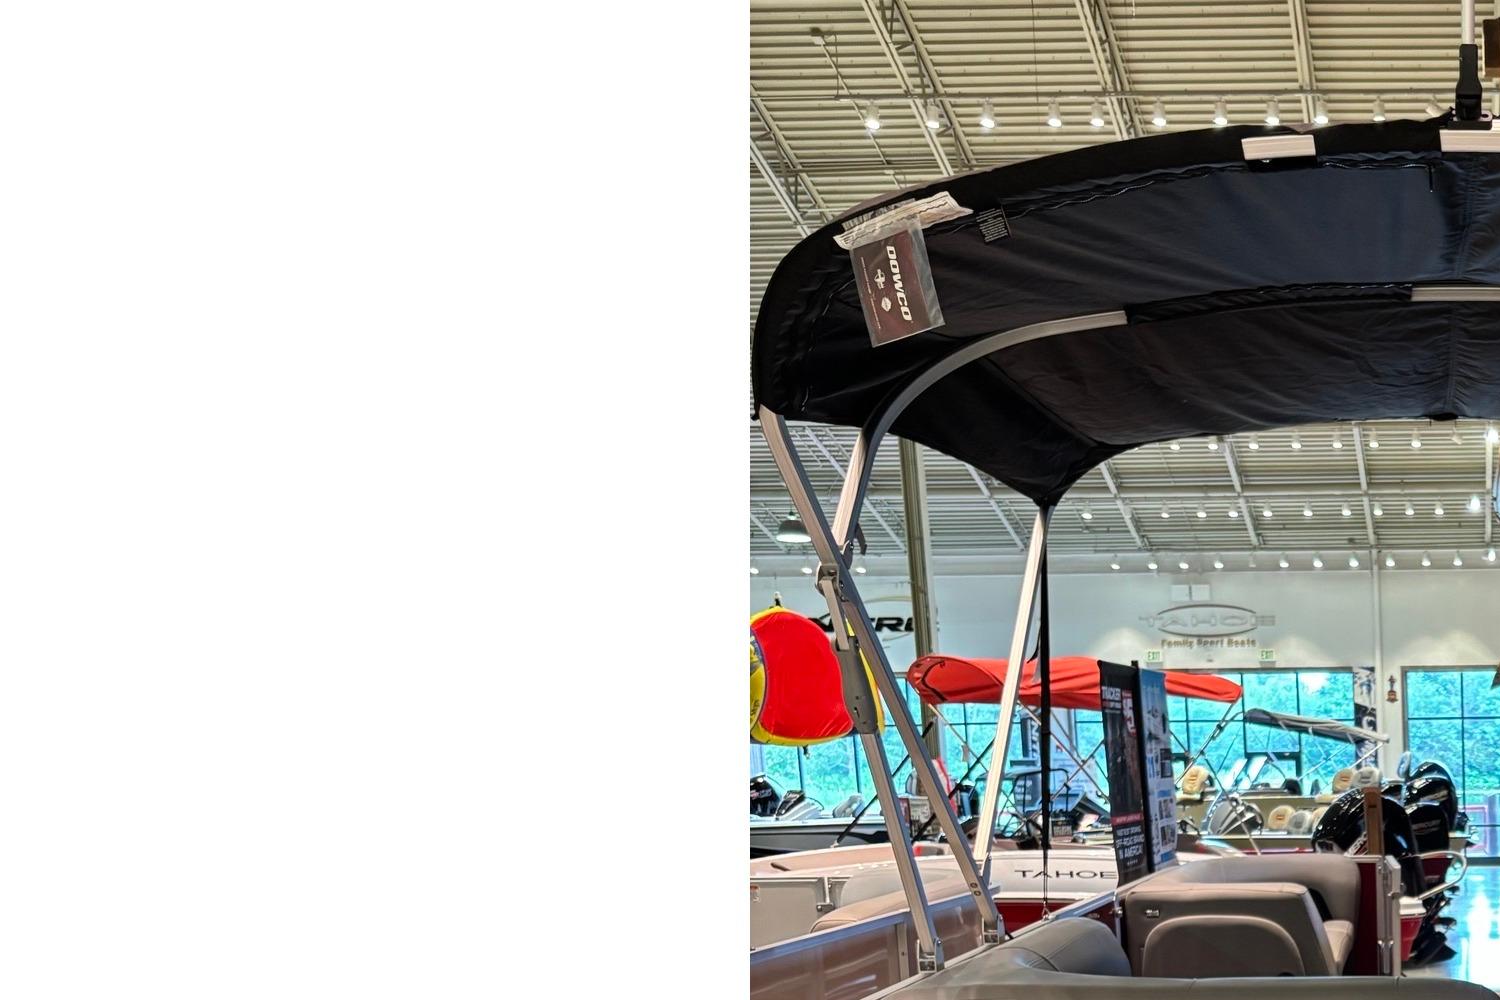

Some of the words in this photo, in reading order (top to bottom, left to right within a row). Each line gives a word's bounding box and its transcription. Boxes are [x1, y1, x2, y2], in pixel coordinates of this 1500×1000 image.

[886, 245, 912, 321] DOWCO
[1138, 614, 1276, 628] TAHOE
[1161, 638, 1193, 649] Family
[1196, 638, 1225, 648] Sport
[1227, 638, 1257, 648] Boats
[1147, 651, 1161, 661] EXIT
[1260, 650, 1274, 660] EXIT
[1014, 870, 1117, 879] TAHOE
